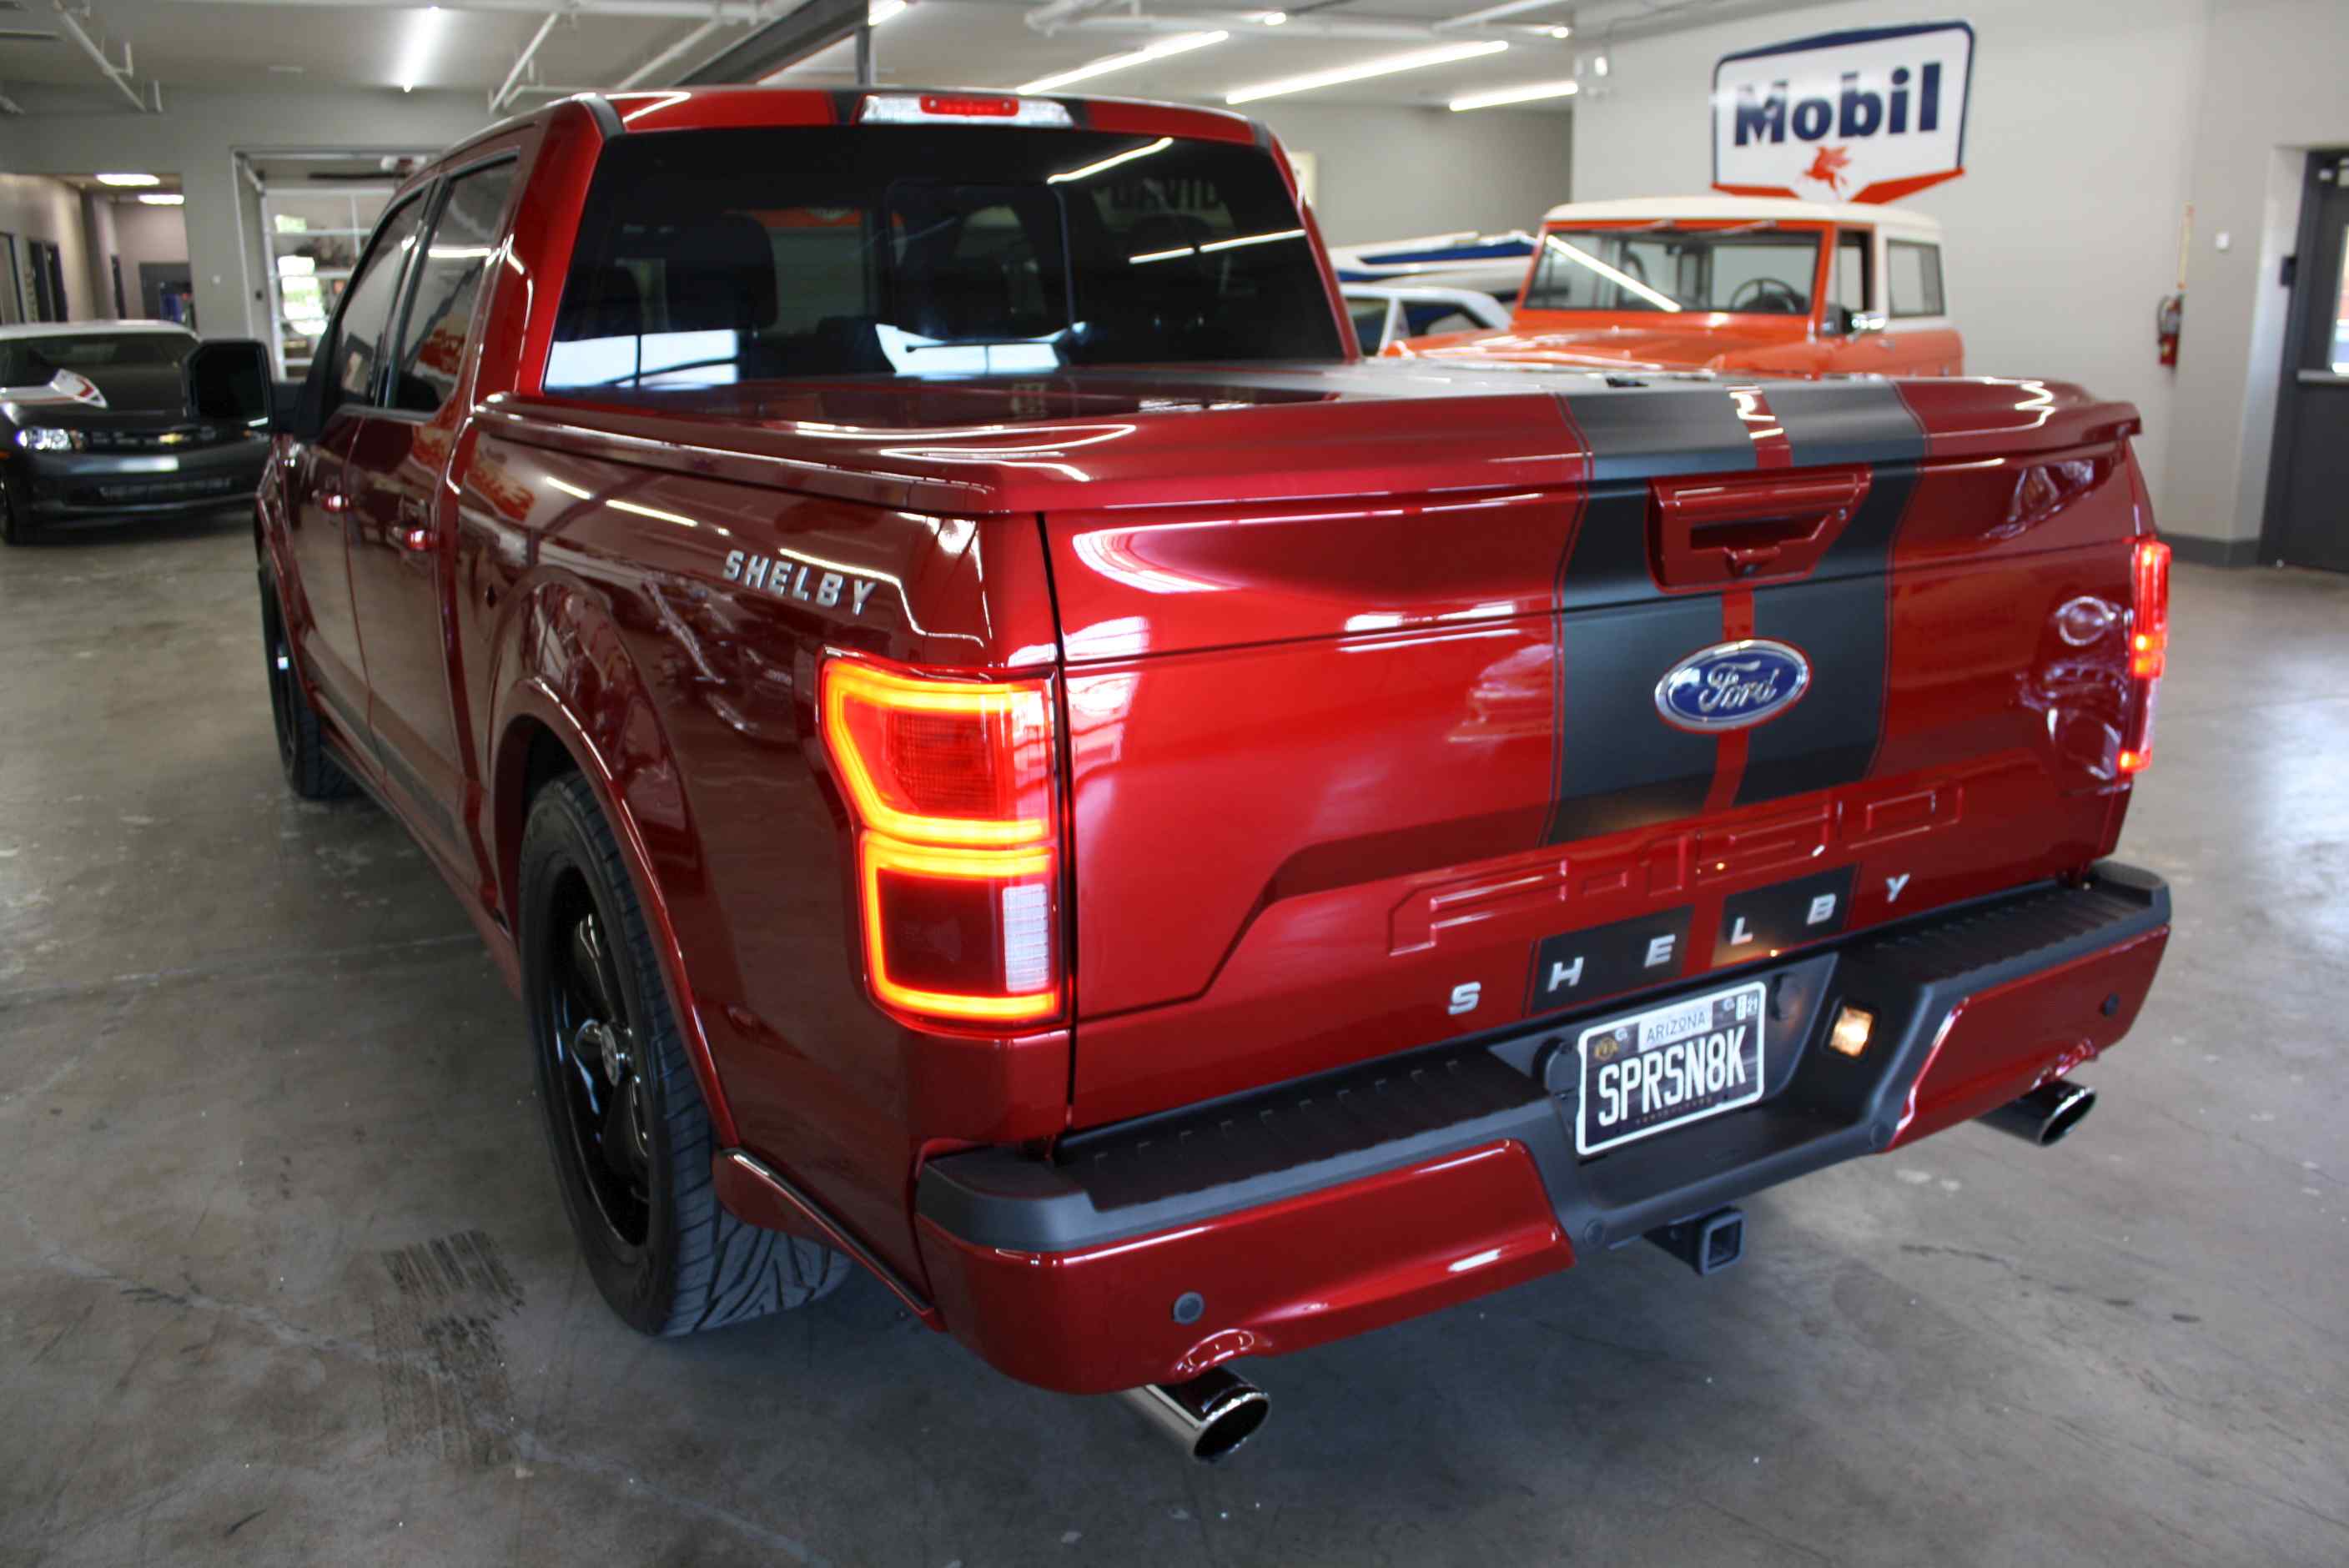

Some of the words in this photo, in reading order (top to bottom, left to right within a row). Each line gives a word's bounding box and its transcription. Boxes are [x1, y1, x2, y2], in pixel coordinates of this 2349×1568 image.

[1734, 62, 1942, 147] Mobil
[722, 550, 875, 616] SHELBY
[1698, 661, 1779, 712] Ford
[1448, 873, 1910, 1015] SHELBY
[1647, 1011, 1705, 1043] ARIZONA
[1597, 1026, 1747, 1127] SPRSN8K
